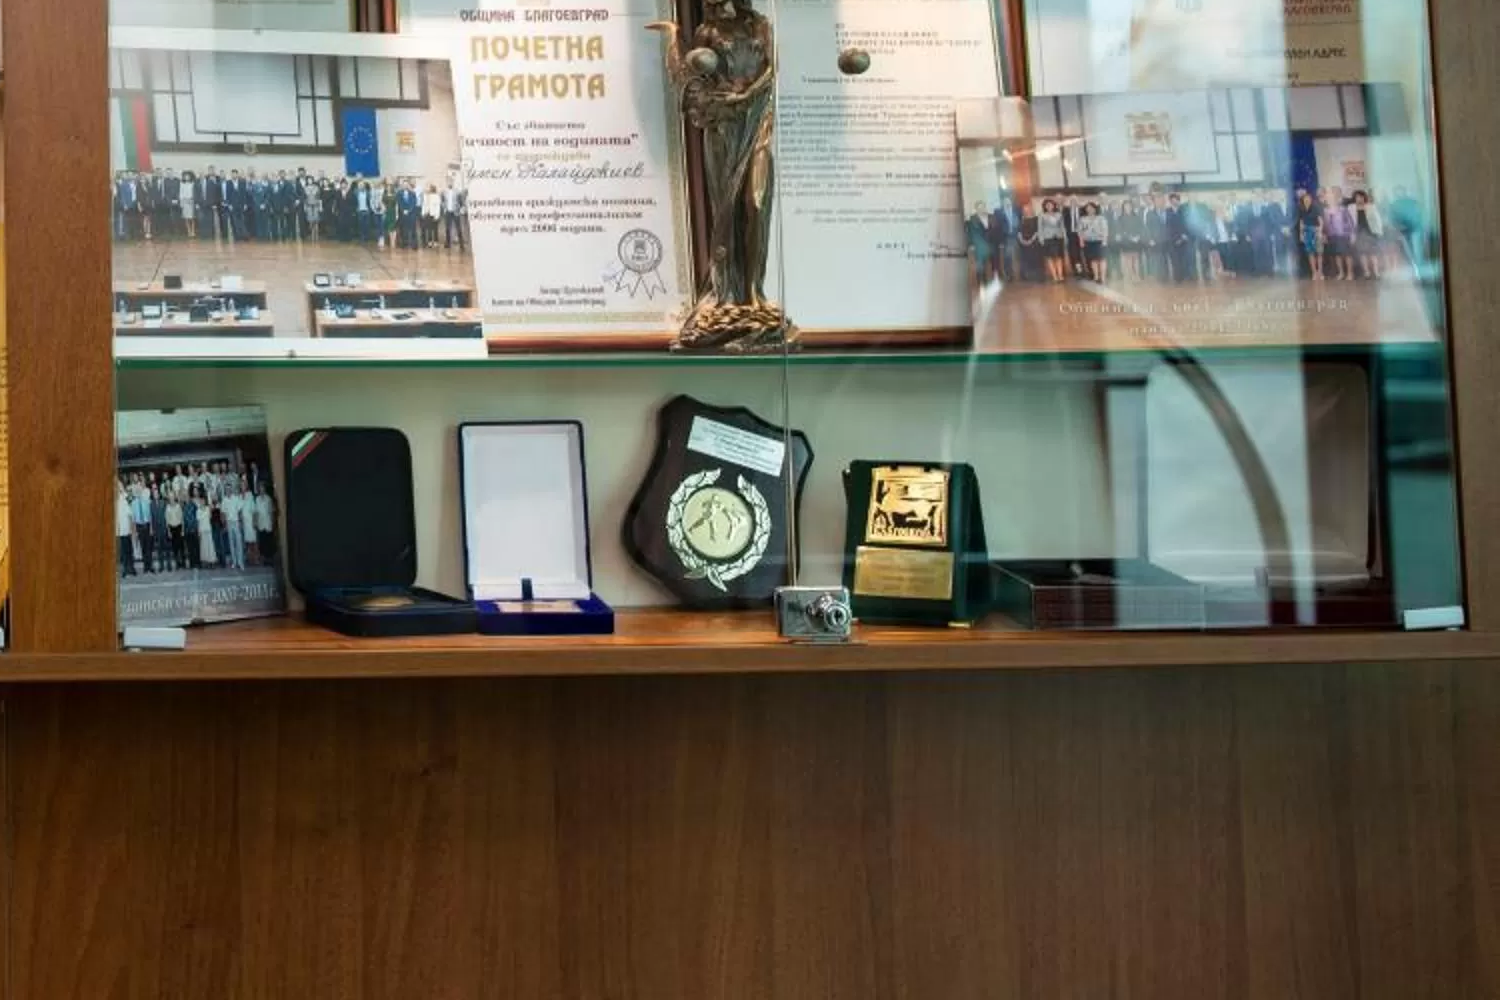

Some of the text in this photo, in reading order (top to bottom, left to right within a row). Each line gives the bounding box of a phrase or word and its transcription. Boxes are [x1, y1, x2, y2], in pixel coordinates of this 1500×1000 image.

[460, 8, 610, 23] ОБЩИНА БЛАГОЕВГРАД
[471, 34, 605, 62] ПОЧЕТНА
[473, 72, 606, 101] ГРАМОТА
[463, 136, 525, 148] ичност
[531, 137, 549, 147] на
